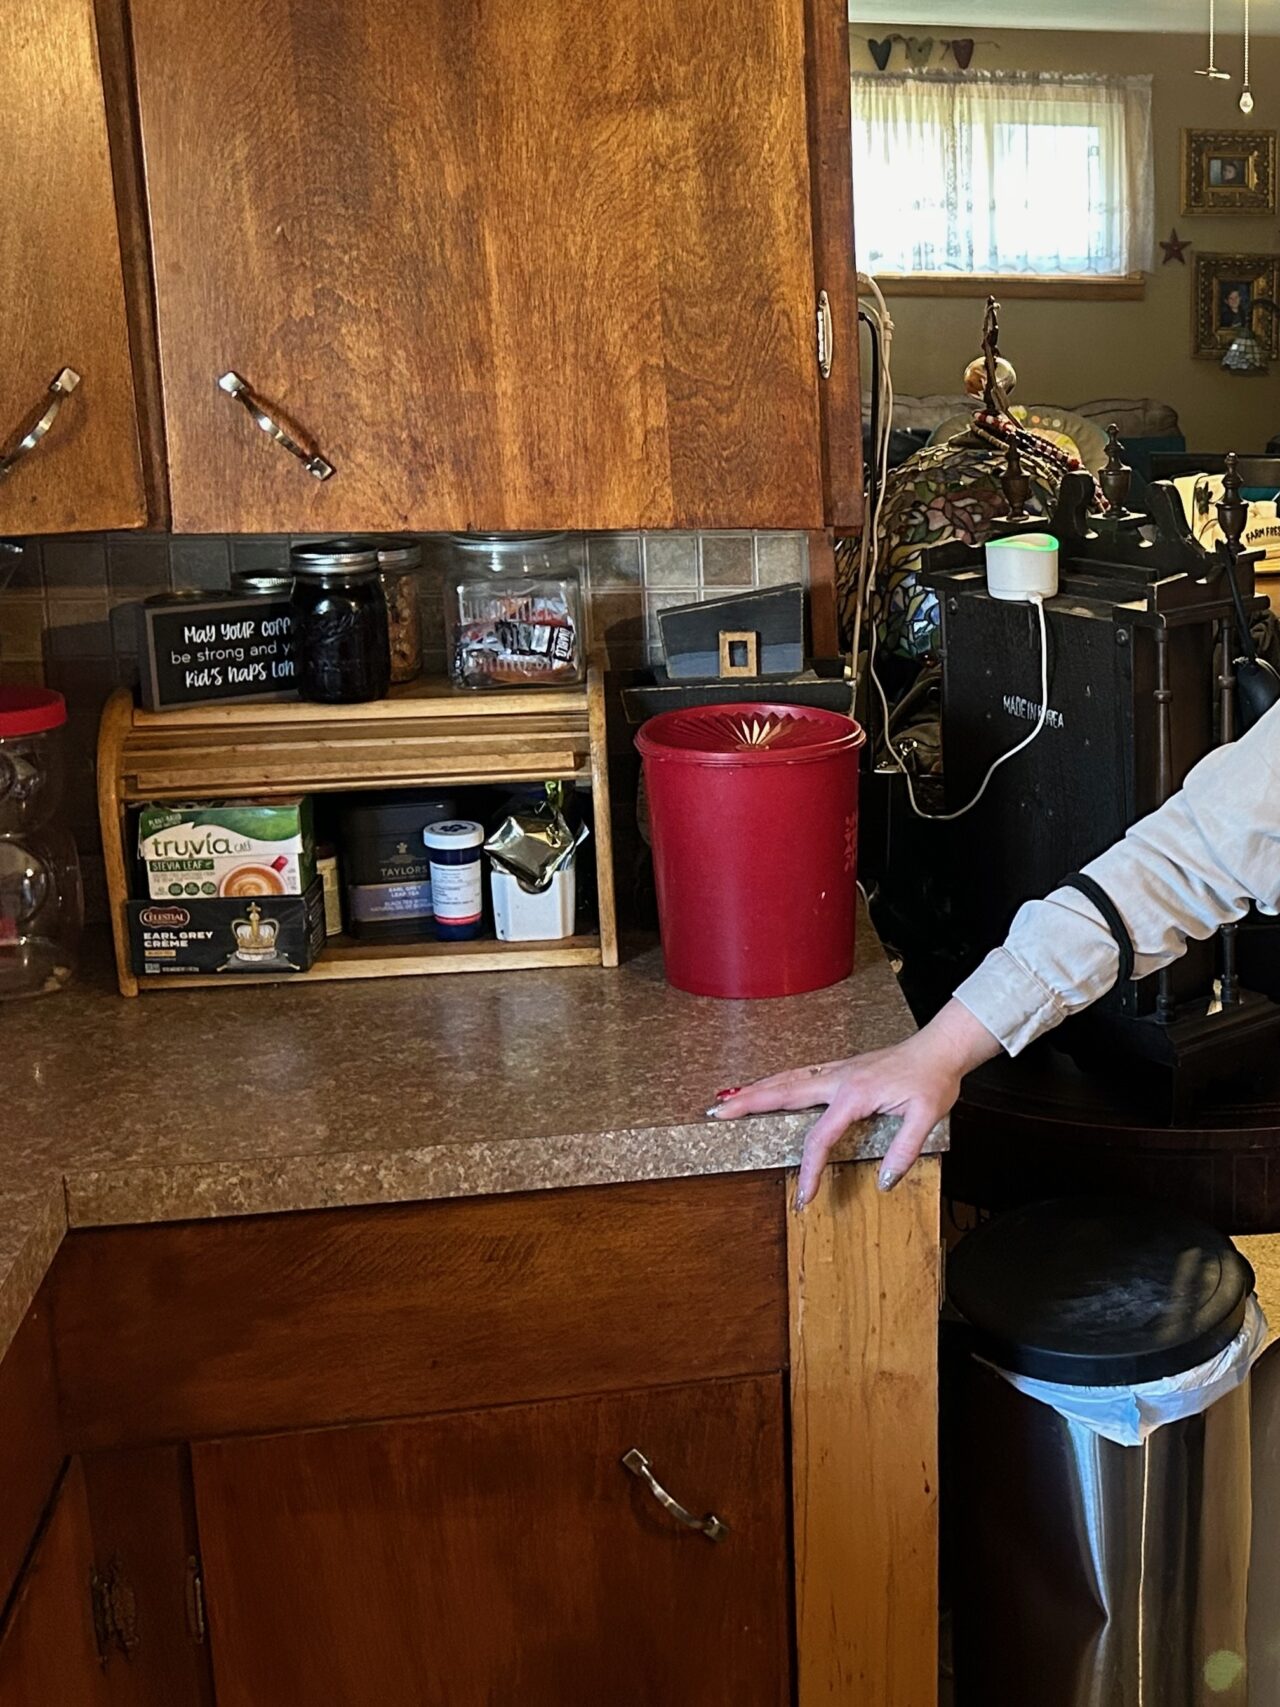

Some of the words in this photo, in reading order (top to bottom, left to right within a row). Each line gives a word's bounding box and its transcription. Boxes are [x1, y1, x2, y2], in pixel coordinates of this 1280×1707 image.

[1246, 528, 1265, 543] FARM
[184, 625, 216, 645] May
[171, 651, 191, 664] be
[197, 647, 244, 661] strong
[250, 641, 277, 656] and
[185, 667, 223, 688] kid's
[228, 661, 268, 683] naps
[272, 659, 295, 679] lon
[1003, 695, 1026, 719] MADE
[1027, 700, 1037, 721] IN
[152, 861, 181, 871] STEVIA
[182, 860, 203, 870] LEAF
[381, 865, 428, 877] TAYLORS
[143, 912, 185, 923] CELESTIAL
[143, 931, 178, 940] EARL
[179, 930, 213, 939] GREY
